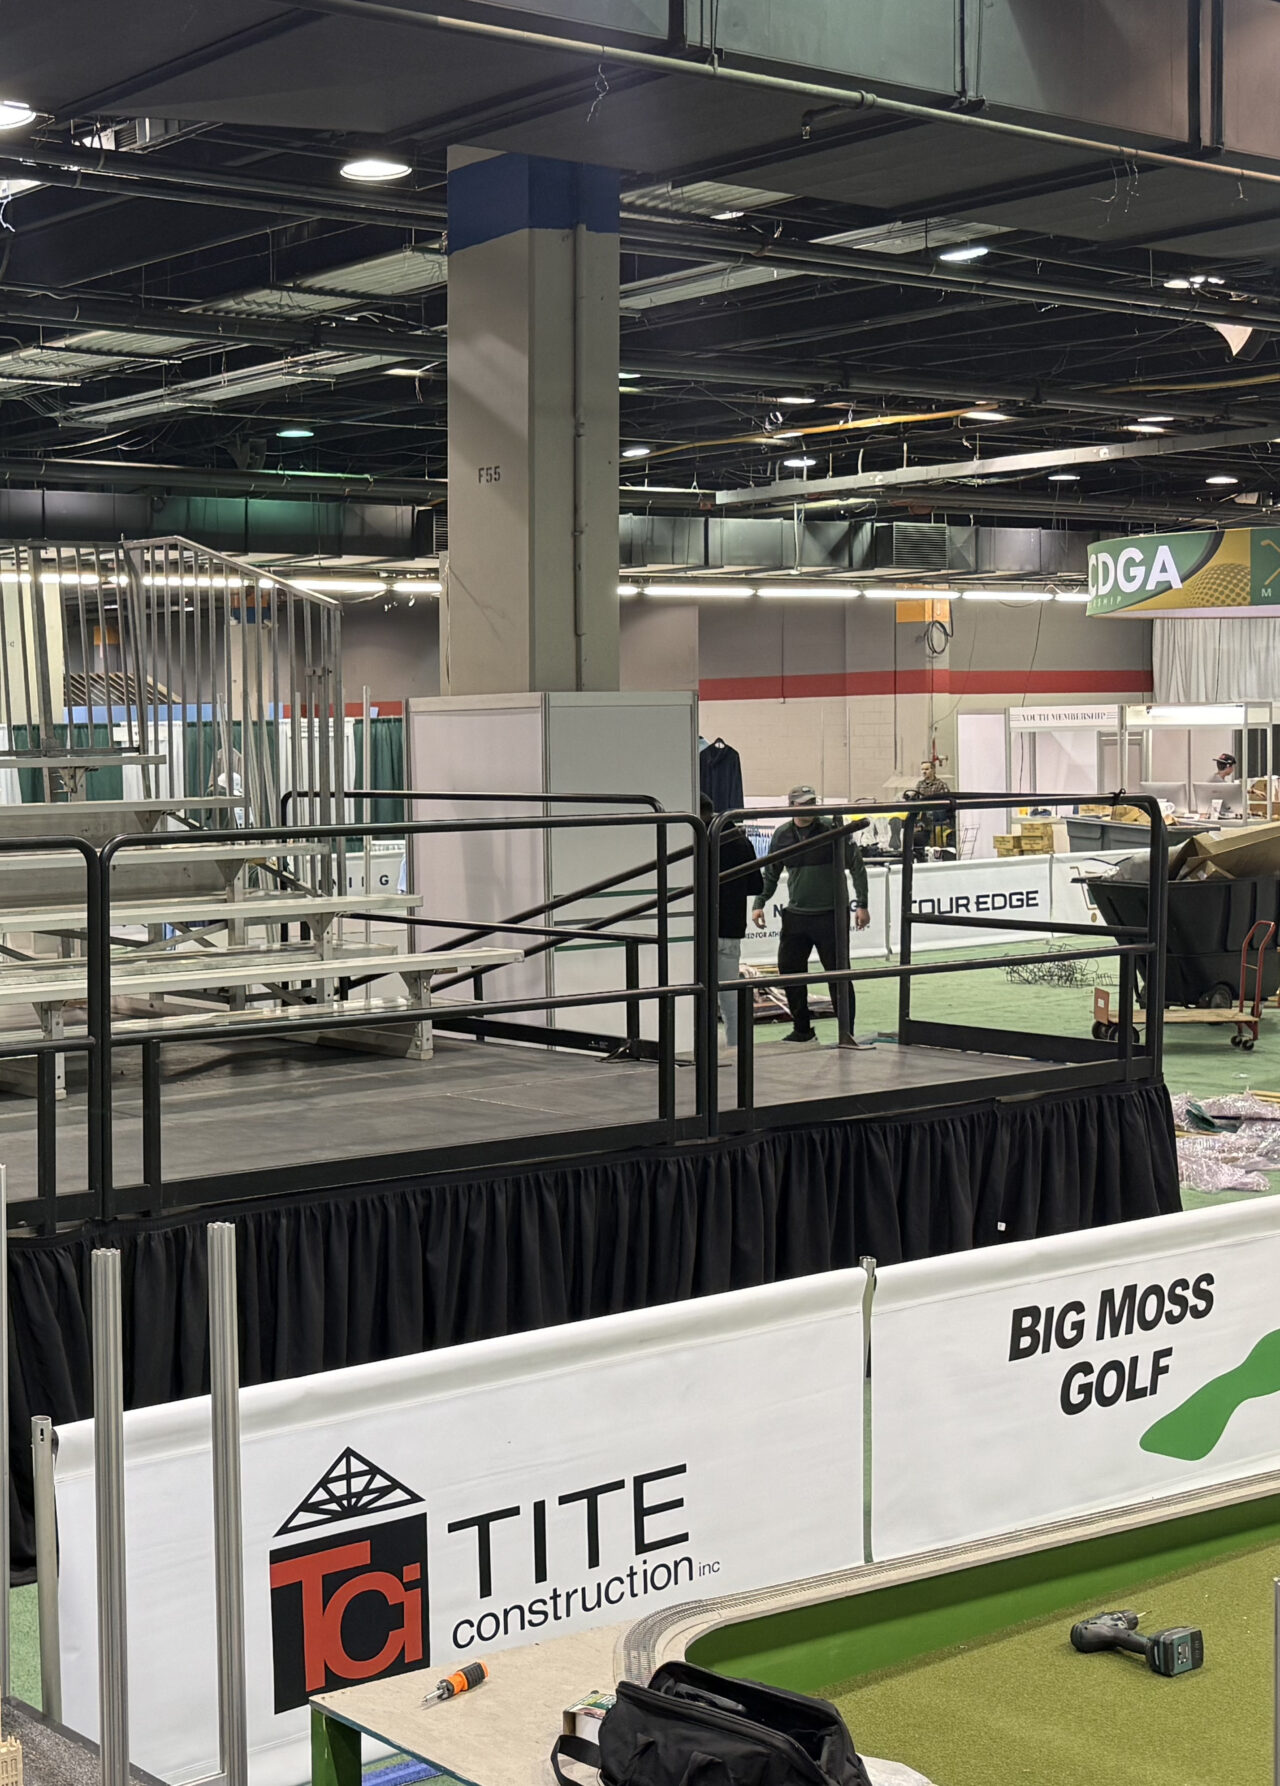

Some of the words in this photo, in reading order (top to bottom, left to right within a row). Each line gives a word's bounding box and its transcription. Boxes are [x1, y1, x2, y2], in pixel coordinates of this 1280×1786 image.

[478, 466, 500, 484] F55
[1089, 545, 1183, 598] CDGA
[1022, 714, 1049, 722] YOUTH
[1051, 712, 1106, 721] MEMBERSHIP
[974, 890, 1039, 912] EDGE
[755, 931, 767, 939] FOR
[1008, 1300, 1086, 1362] BIG
[1095, 1272, 1215, 1341] MOSS
[1060, 1346, 1173, 1416] GOLF
[447, 1463, 689, 1599] TITE
[451, 1556, 694, 1649] construction
[698, 1558, 721, 1578] inc
